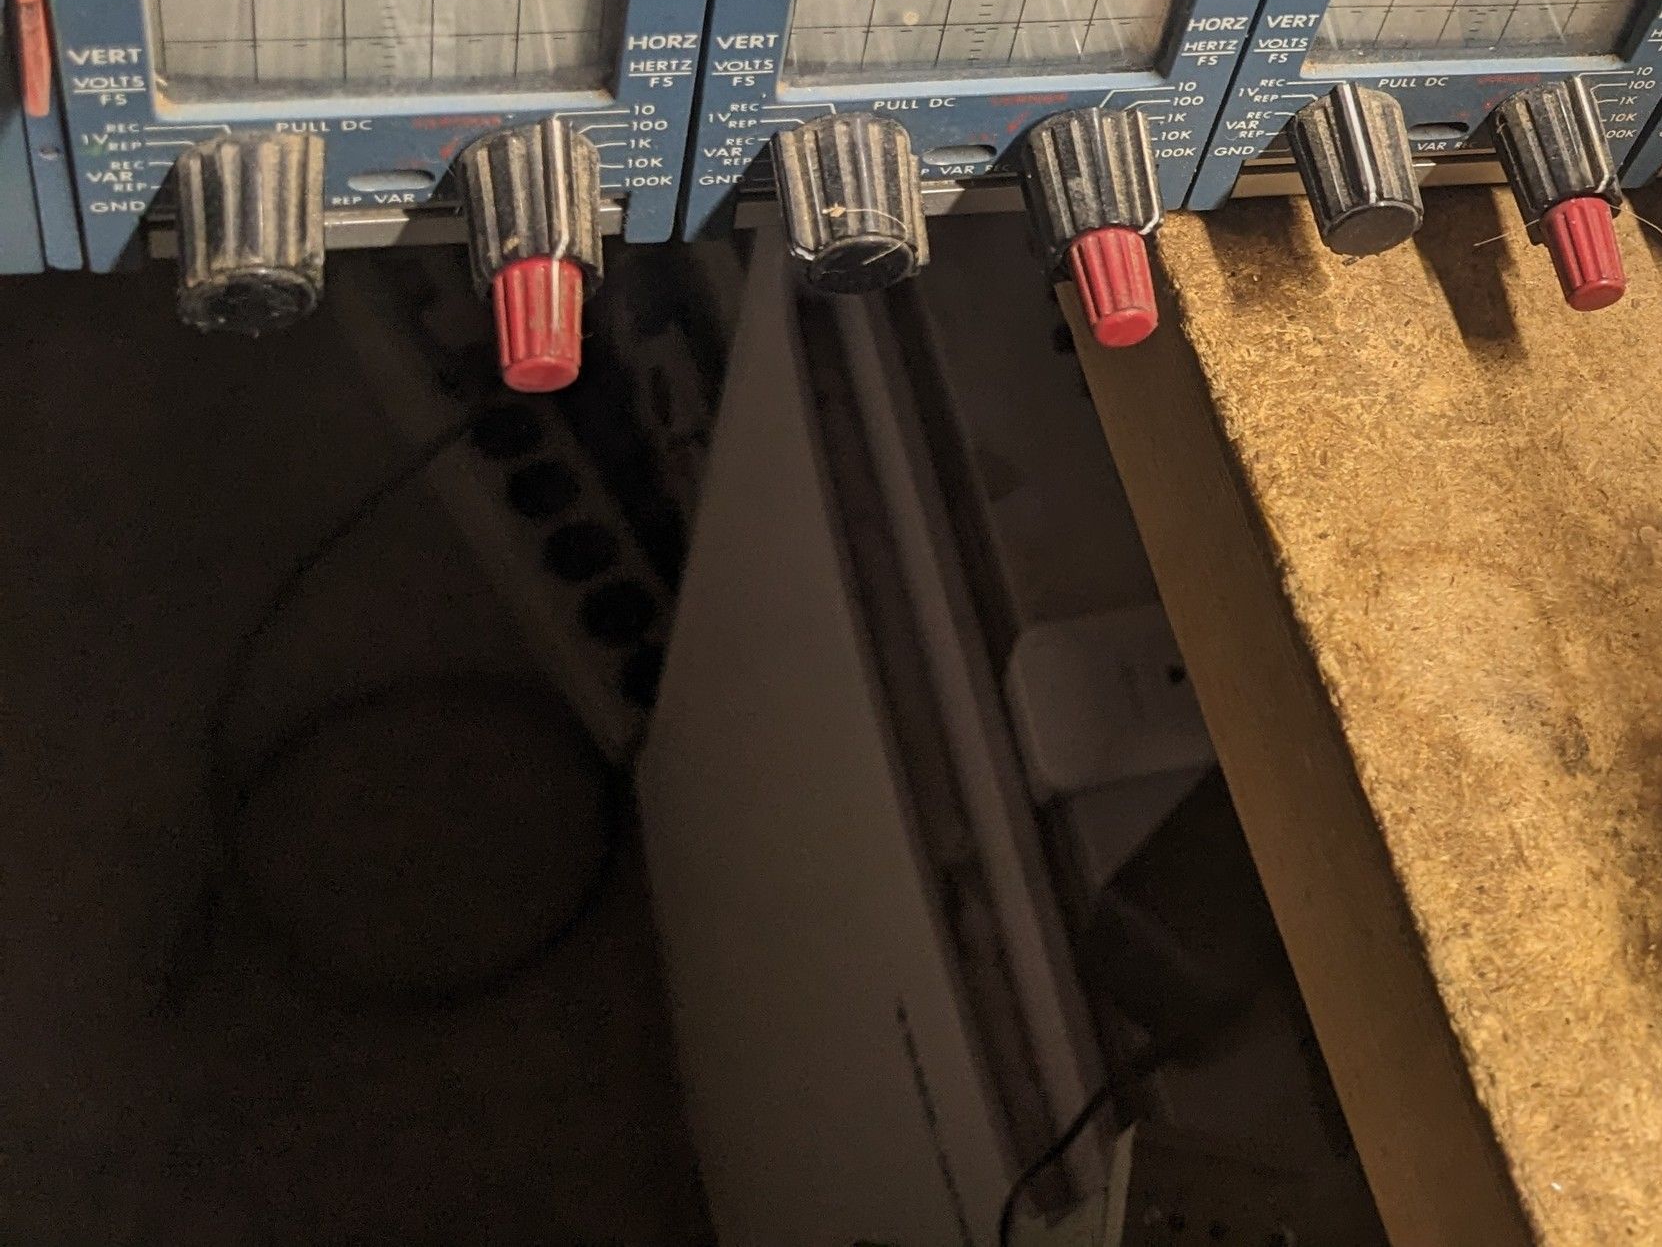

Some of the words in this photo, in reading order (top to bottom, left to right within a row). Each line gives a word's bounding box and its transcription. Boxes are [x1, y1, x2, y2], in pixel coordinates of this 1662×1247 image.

[1188, 16, 1249, 31] HORZ
[1267, 14, 1321, 28] VERT
[627, 34, 698, 50] HORZ
[716, 34, 779, 50] VERT
[1184, 39, 1238, 52] HERTZ
[1258, 38, 1308, 49] VOLTS
[68, 48, 143, 65] VERT
[1197, 55, 1218, 67] FS
[1268, 53, 1288, 64] FS
[629, 60, 693, 72] HERTZ
[714, 59, 774, 72] VOLTS
[1636, 66, 1654, 76] 10
[73, 76, 146, 89] VOLTS
[650, 76, 674, 88] FS
[732, 76, 755, 86] FS
[1178, 81, 1197, 92] 10
[1260, 79, 1285, 88] REC
[1378, 78, 1417, 89] PULL
[1424, 76, 1449, 88] DC
[1628, 80, 1656, 90] 100
[1239, 87, 1260, 97] 1V
[100, 94, 128, 106] FS
[873, 100, 918, 111] PULL
[929, 97, 956, 108] DC
[1173, 96, 1204, 106] 100
[1253, 94, 1279, 104] REP
[1619, 96, 1638, 105] 1K
[634, 105, 656, 116] 10
[730, 104, 760, 113] REC
[709, 113, 731, 123] 1V
[1167, 113, 1187, 123] 1K
[1246, 111, 1273, 120] REC
[1610, 112, 1638, 123] 10K
[105, 123, 140, 133] REC
[275, 121, 331, 134] PULL
[340, 119, 373, 132] DC
[631, 120, 668, 131] 100
[728, 119, 757, 129] REP
[1226, 120, 1259, 130] VAR
[81, 134, 108, 145] 1V
[1161, 131, 1193, 141] 10K
[1239, 130, 1265, 139] REP
[1606, 129, 1638, 139] 00K
[107, 141, 142, 151] REP
[629, 138, 652, 149] 1K
[725, 137, 755, 146] REC
[1417, 141, 1447, 151] VAR
[704, 147, 743, 158] VAR
[1155, 147, 1196, 158] 100K
[1214, 145, 1255, 157] GND
[110, 160, 145, 170] REC
[627, 158, 664, 169] 10K
[723, 157, 753, 167] REP
[940, 164, 975, 175] VAR
[86, 171, 134, 183] VAR
[624, 176, 673, 187] 100K
[699, 174, 744, 186] GND
[113, 182, 147, 192] REP
[374, 193, 415, 204] VAR
[89, 201, 146, 214] GND
